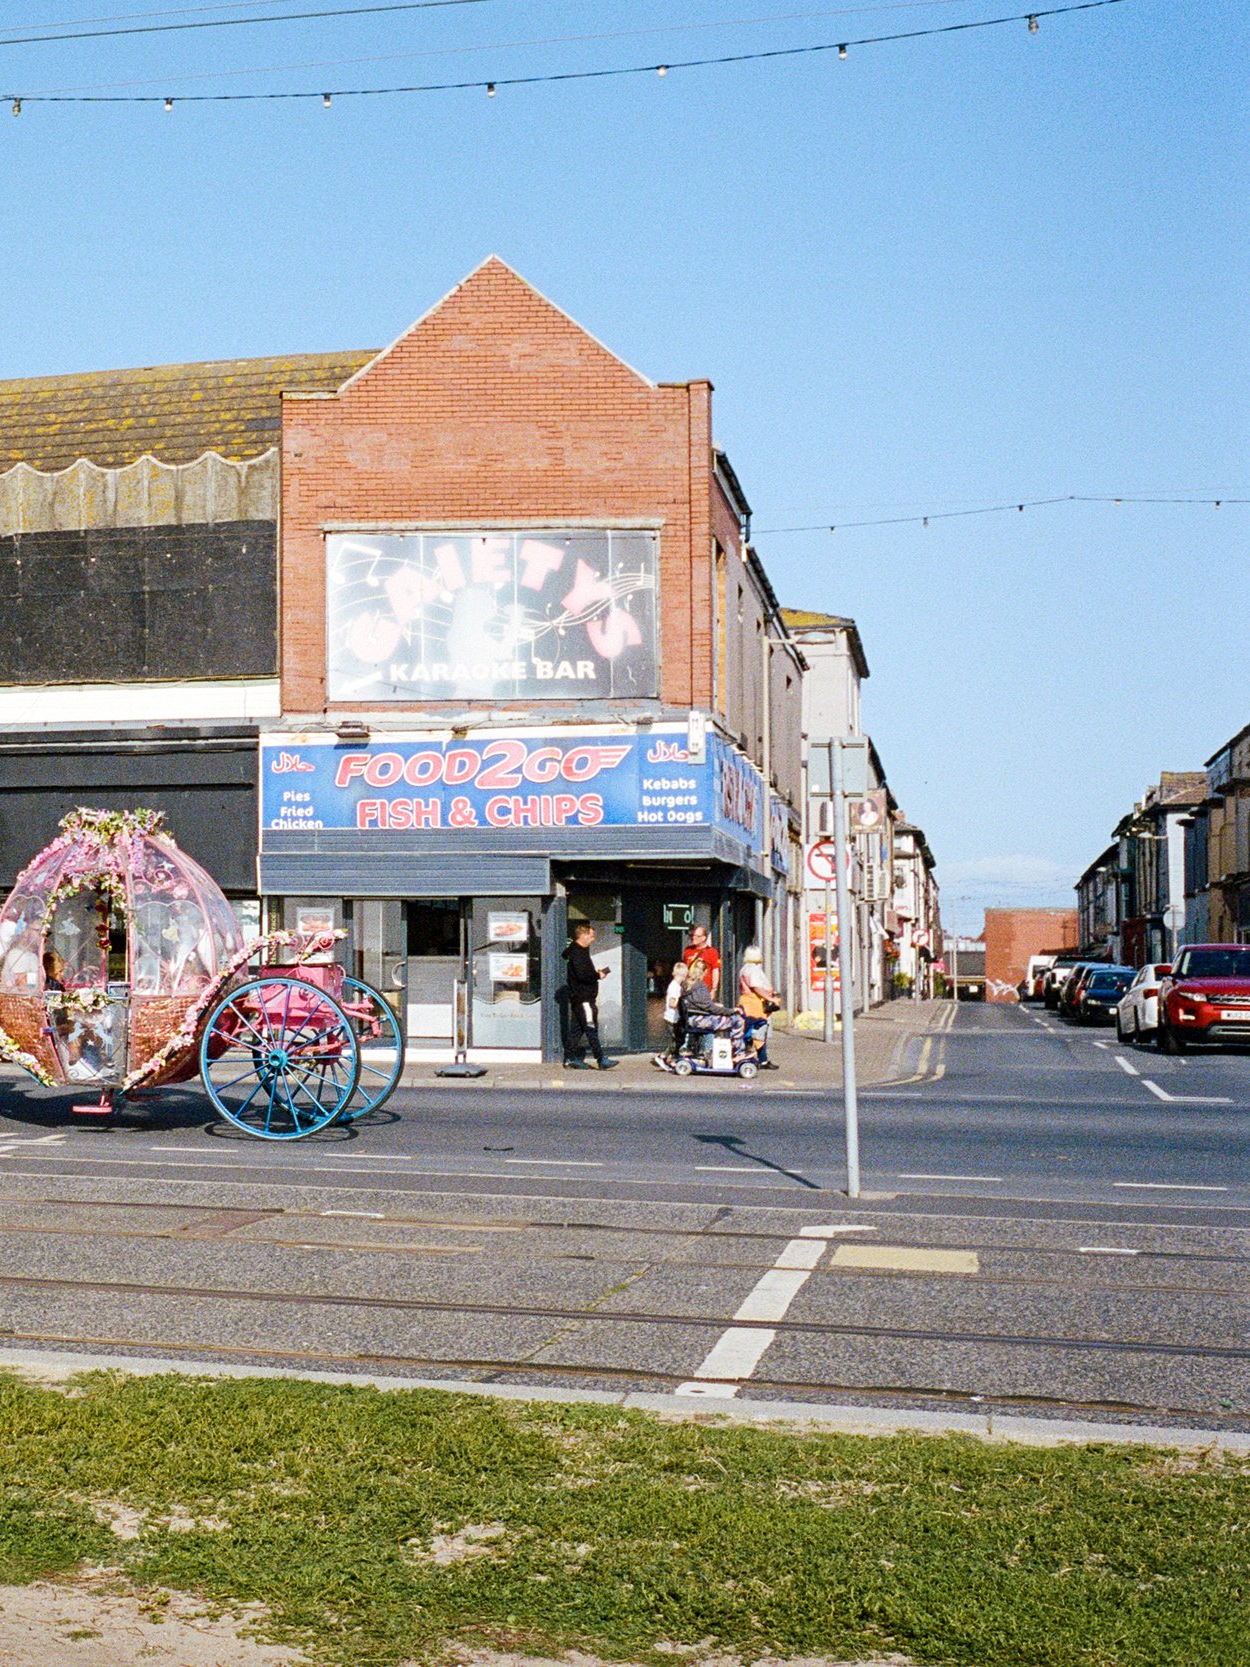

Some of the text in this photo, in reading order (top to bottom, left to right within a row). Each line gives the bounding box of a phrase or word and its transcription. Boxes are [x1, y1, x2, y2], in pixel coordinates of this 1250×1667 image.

[390, 659, 596, 682] KARAOKE BAR
[271, 751, 316, 774] حلال
[335, 739, 633, 789] FOOD2GO
[642, 778, 697, 790] Kebabs
[283, 790, 311, 801] Pies
[642, 795, 698, 808] Burgers
[280, 805, 314, 817] Fried
[357, 792, 604, 829] FISH & CHIPS
[637, 810, 664, 822] Hot
[271, 818, 323, 830] Chicken
